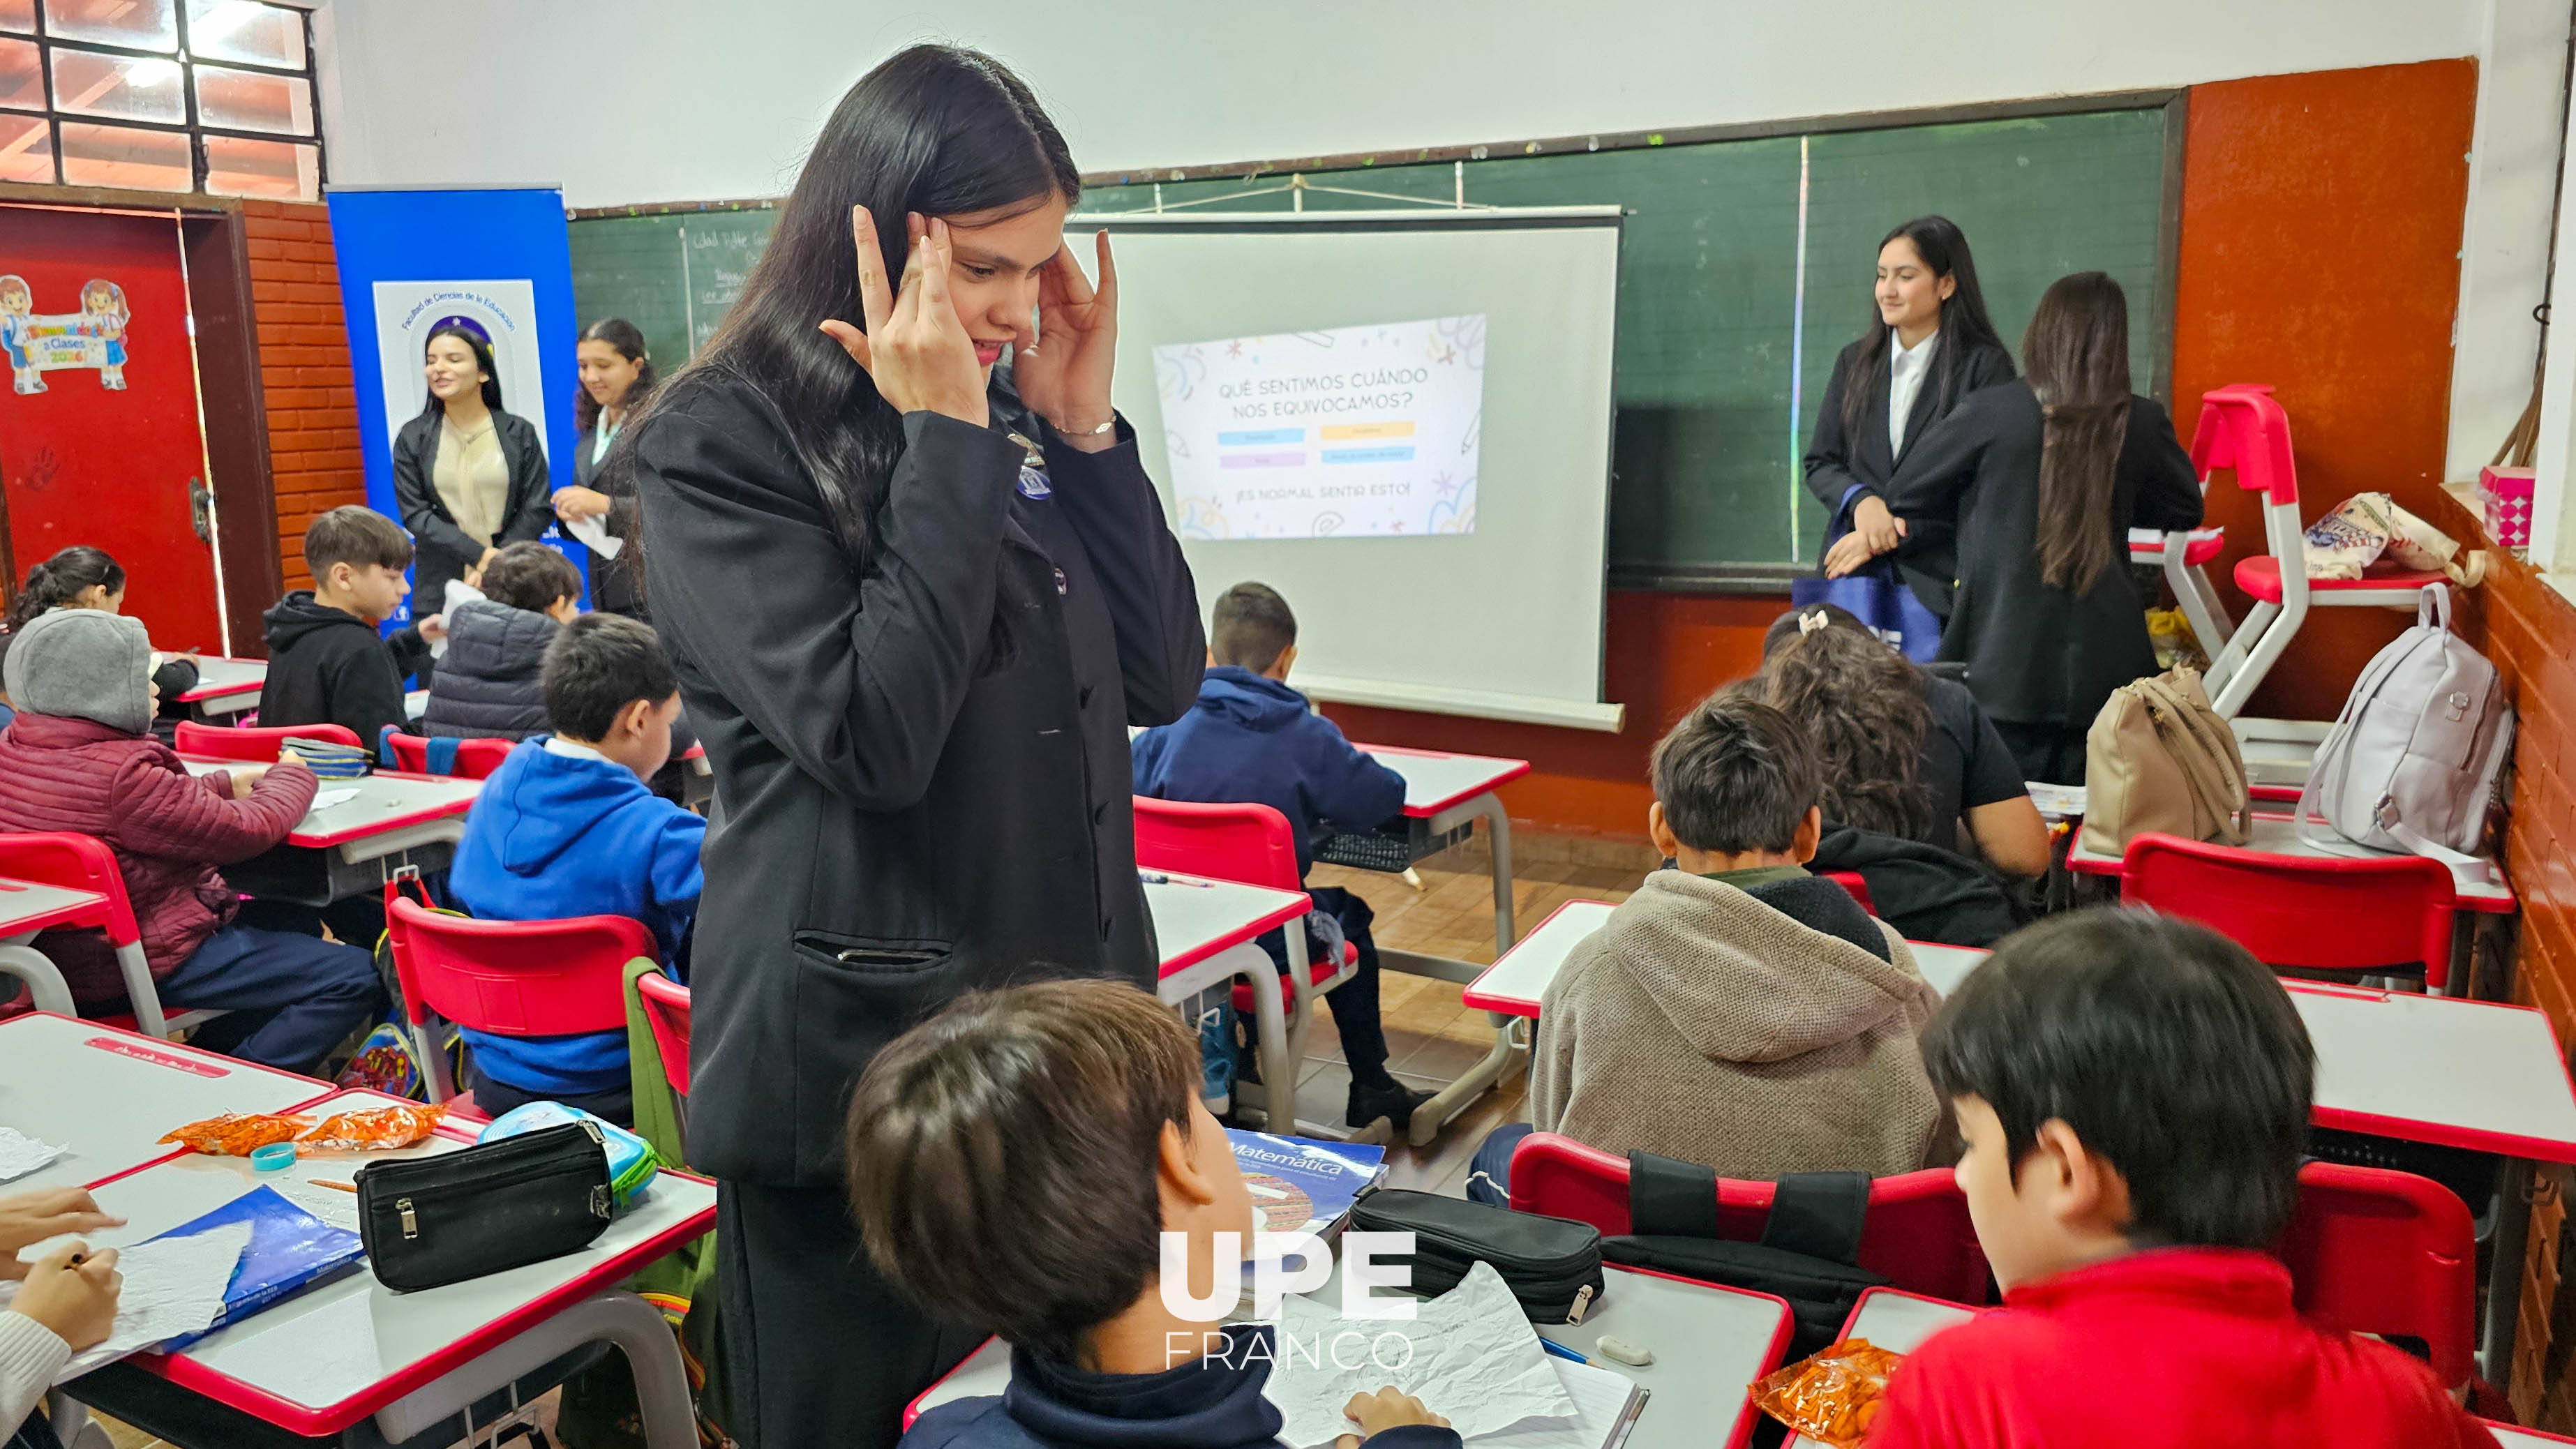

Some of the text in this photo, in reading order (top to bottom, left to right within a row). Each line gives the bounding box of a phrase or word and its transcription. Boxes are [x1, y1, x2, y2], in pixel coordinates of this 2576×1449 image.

[424, 297, 434, 307] de
[433, 292, 464, 302] Ciencias
[465, 292, 475, 301] de
[476, 294, 483, 303] la
[51, 338, 86, 350] Clases
[1219, 368, 1428, 398] QUÉ SENTIMOS CUÁNDO
[1233, 391, 1414, 419] NOS EQUIVOCAMOS?
[1259, 486, 1315, 501] NORMAL
[1320, 485, 1366, 499] SENTIR
